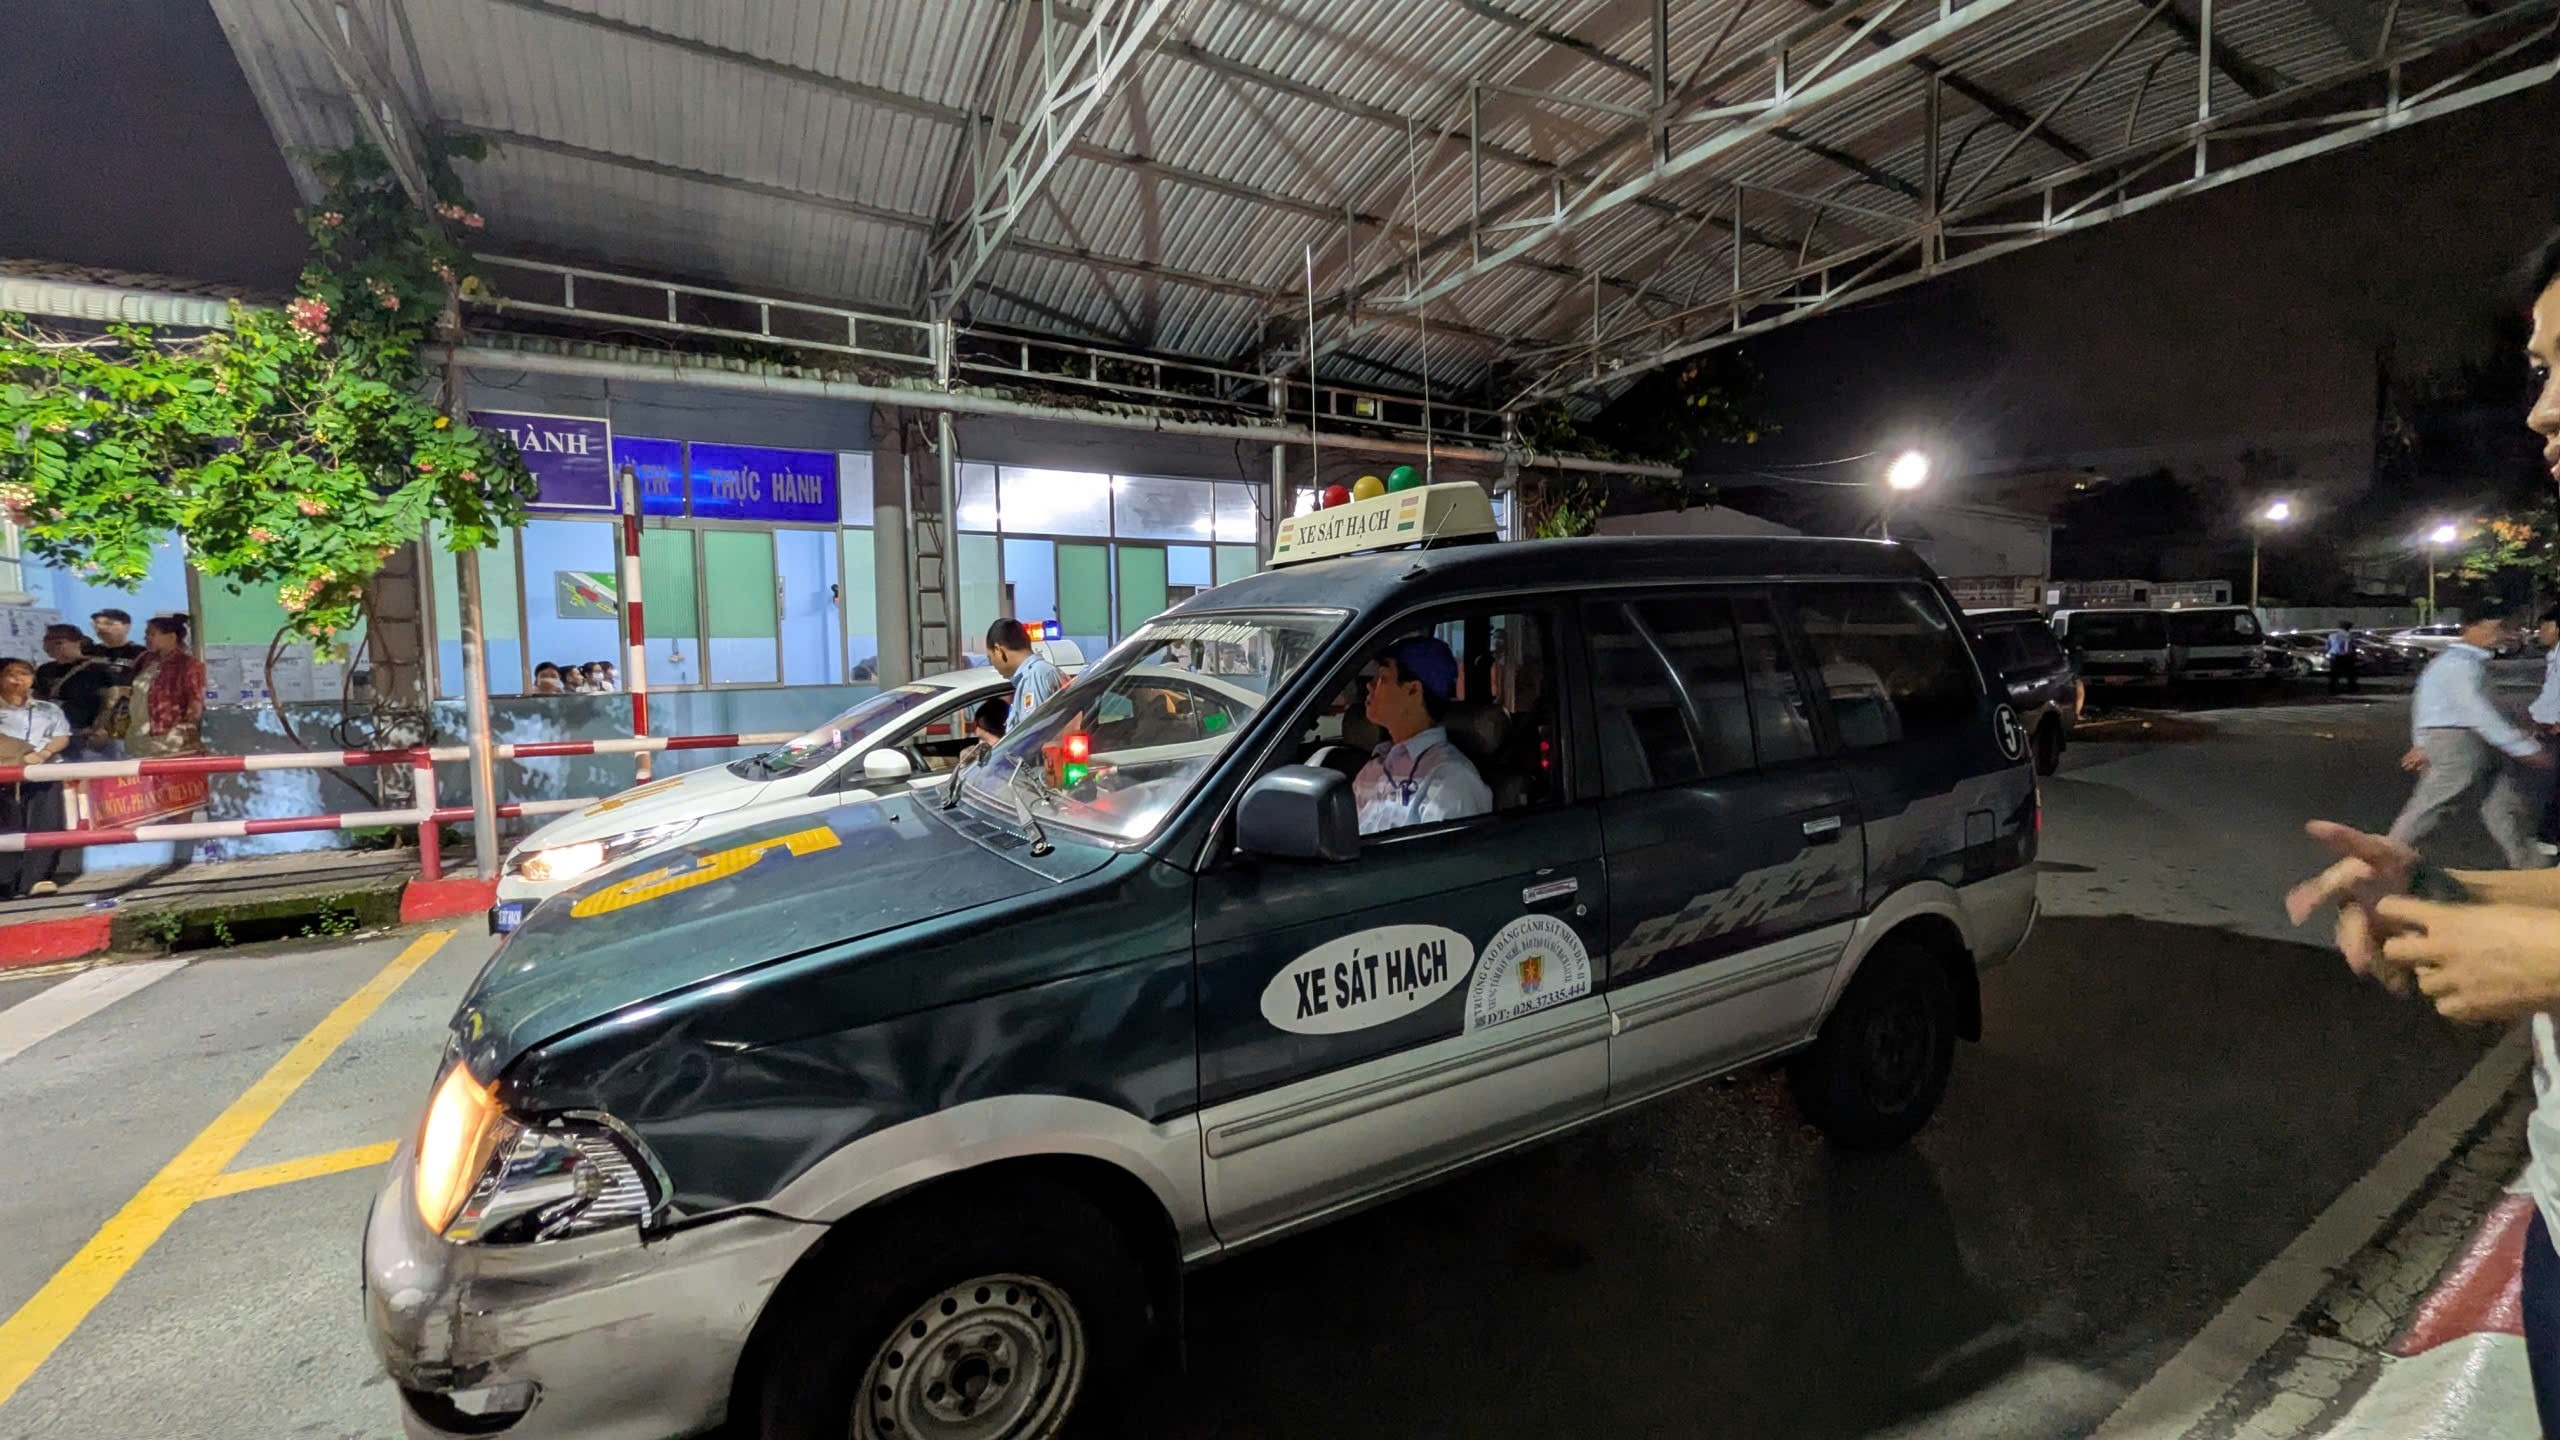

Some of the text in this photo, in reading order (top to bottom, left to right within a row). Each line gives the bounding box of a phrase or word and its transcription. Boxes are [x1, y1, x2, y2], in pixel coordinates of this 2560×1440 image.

[710, 466, 760, 507] THỰC
[771, 466, 822, 504] HÀNH
[1297, 509, 1391, 545] XE SÁT HẠCH
[2001, 710, 2017, 752] 5
[1483, 948, 1498, 971] CAO
[1544, 920, 1560, 935] SÁT
[1293, 939, 1448, 1020] XE SÁT HẠCH
[1513, 981, 1586, 1016] 028.37335.444
